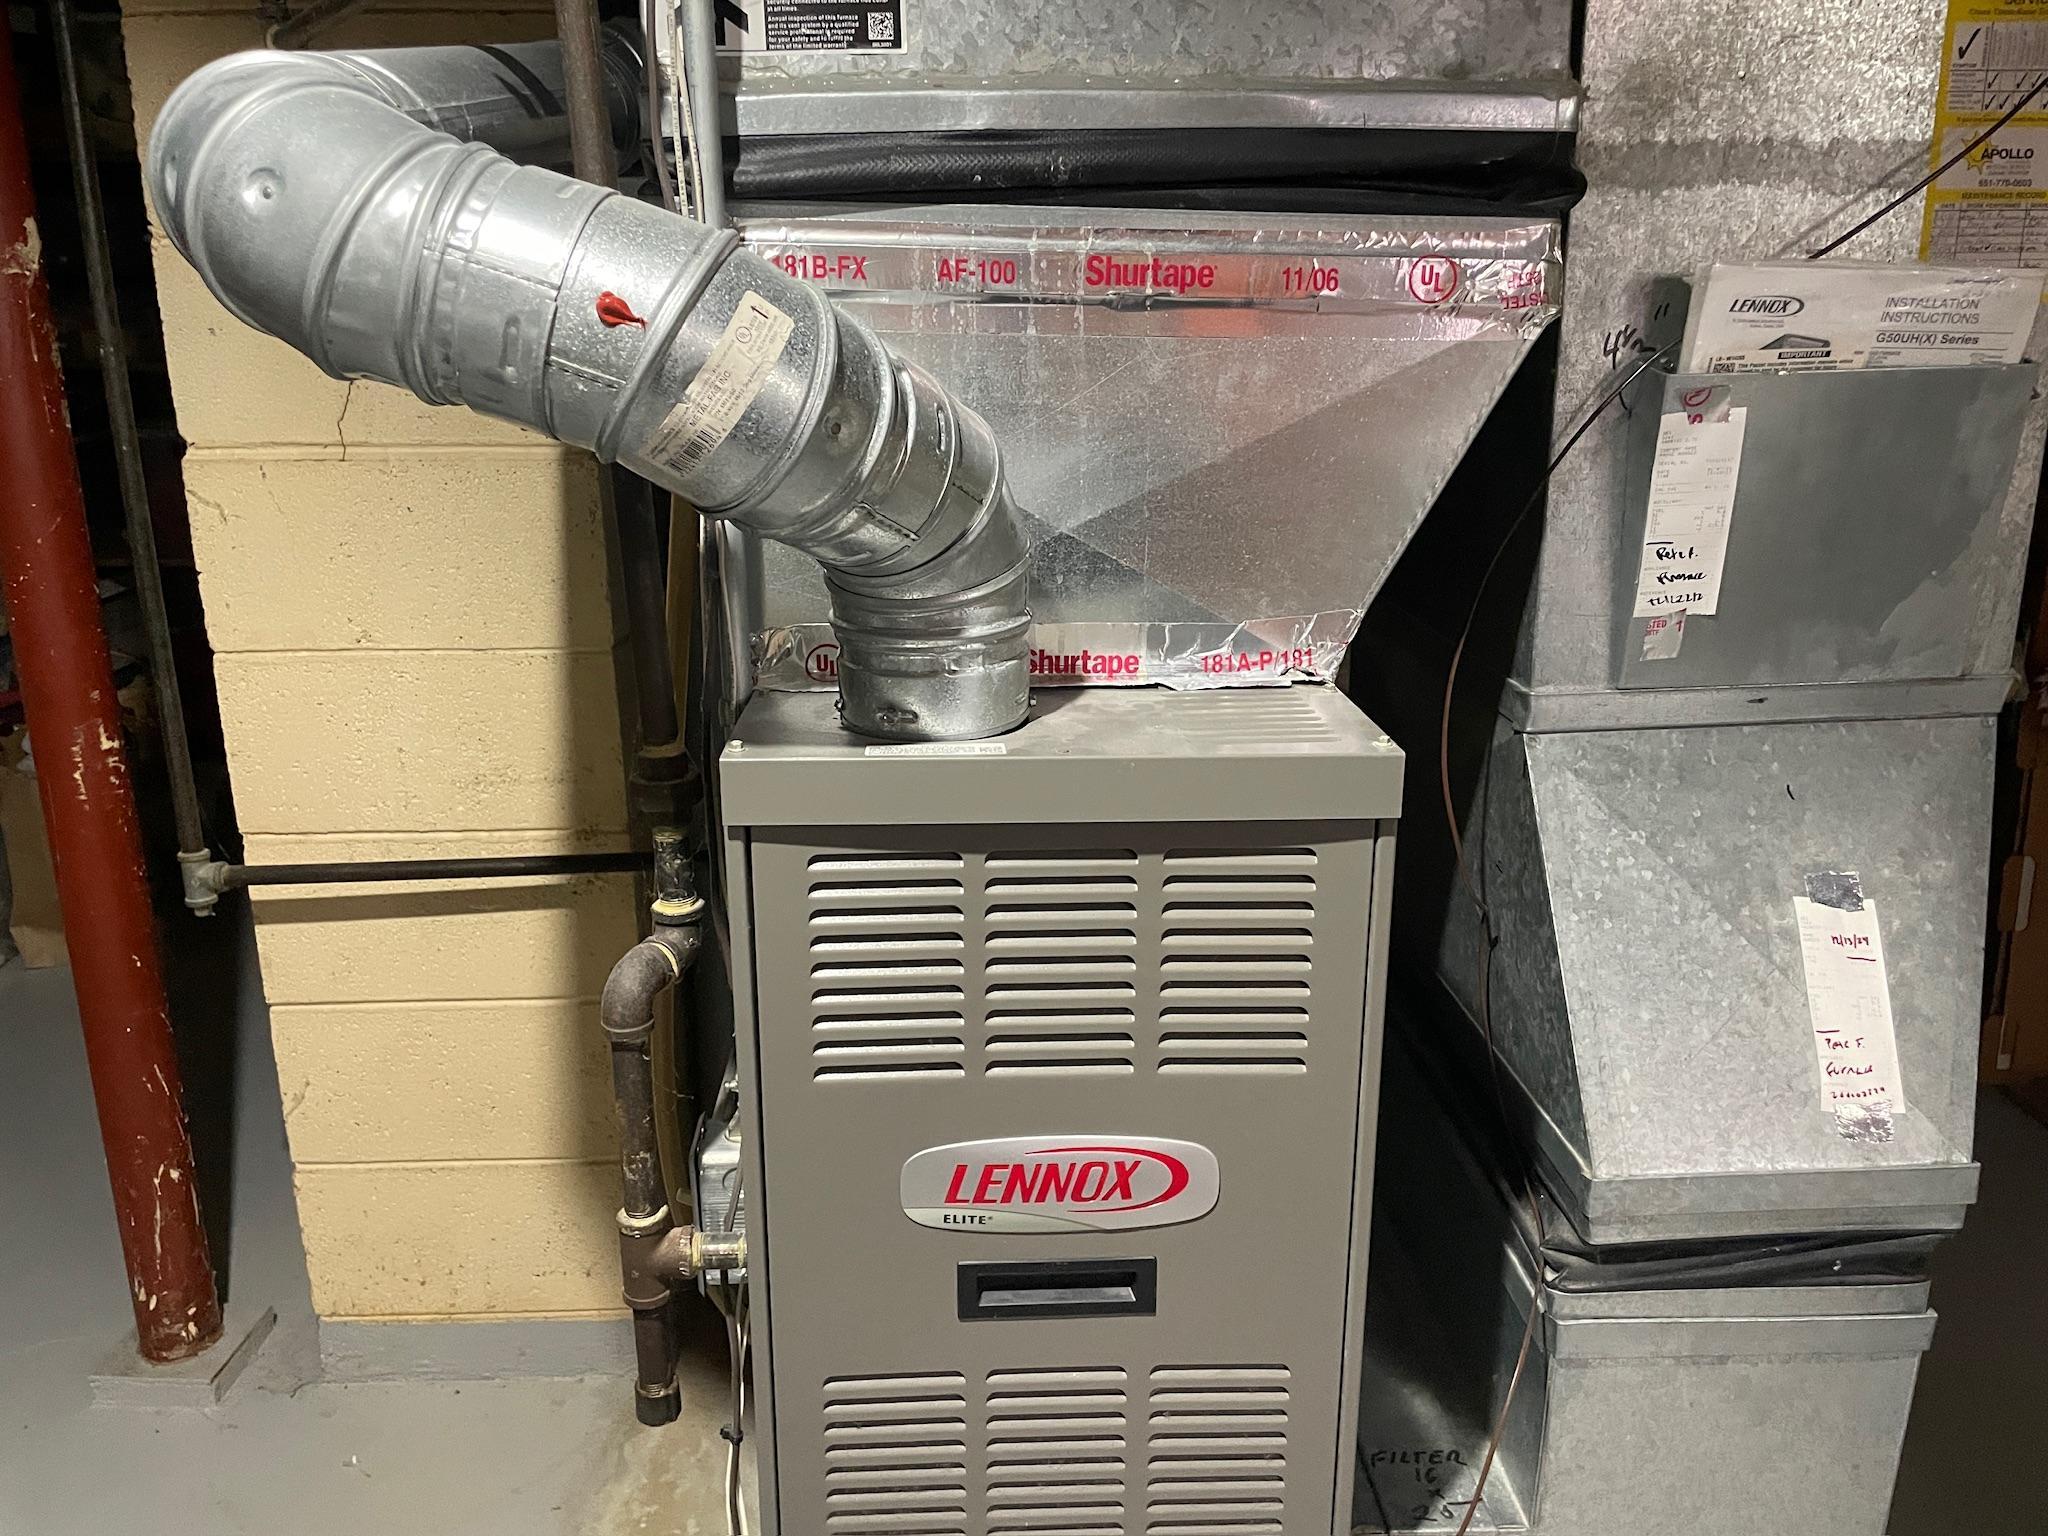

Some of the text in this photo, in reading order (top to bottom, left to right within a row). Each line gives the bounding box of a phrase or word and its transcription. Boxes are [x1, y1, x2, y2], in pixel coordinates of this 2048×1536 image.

[1981, 148, 2034, 160] APOLLO
[1961, 191, 2047, 200] MAINTENANCE RECORD
[773, 255, 867, 281] 181B-FX
[937, 258, 1016, 284] AF-100
[1085, 255, 1215, 294] Shurtape
[1281, 266, 1339, 292] 11/06
[1728, 298, 1792, 313] LENNOX
[1885, 296, 1980, 310] INSTALLATION
[1880, 311, 1980, 325] INSTRUCTIONS
[1876, 332, 1980, 347] G50UH(X) Series
[1779, 350, 1827, 359] IMPORTANT
[1200, 646, 1314, 675] 181A-P/181
[943, 1160, 1142, 1205] LENNOX
[943, 1213, 987, 1225] ELITE
[1370, 1449, 1468, 1468] FILTER
[1415, 1467, 1438, 1484] 16
